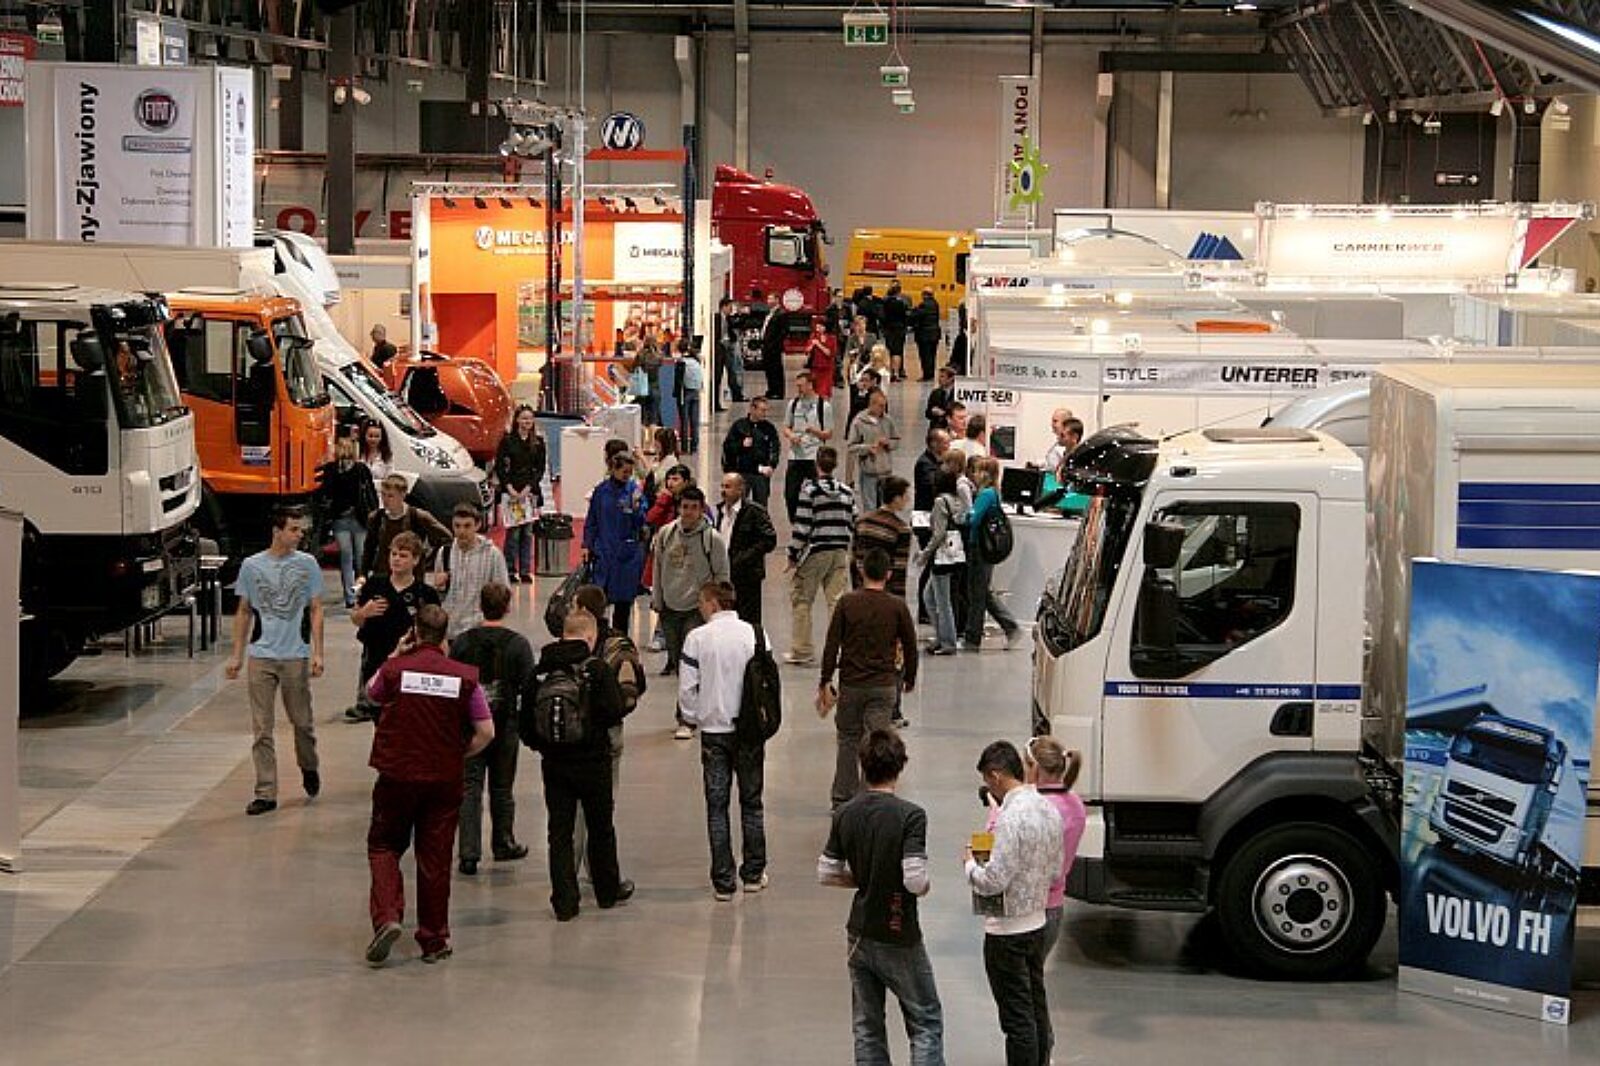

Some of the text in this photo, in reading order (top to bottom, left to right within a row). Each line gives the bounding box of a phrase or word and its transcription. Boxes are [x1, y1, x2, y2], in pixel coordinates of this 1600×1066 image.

[1013, 85, 1028, 135] PONY
[495, 230, 575, 247] MEGAX
[643, 247, 685, 259] MEGAL
[1220, 365, 1319, 383] UNTERER
[958, 389, 1013, 403] UNTERER
[1427, 892, 1552, 956] VOLVO FH
